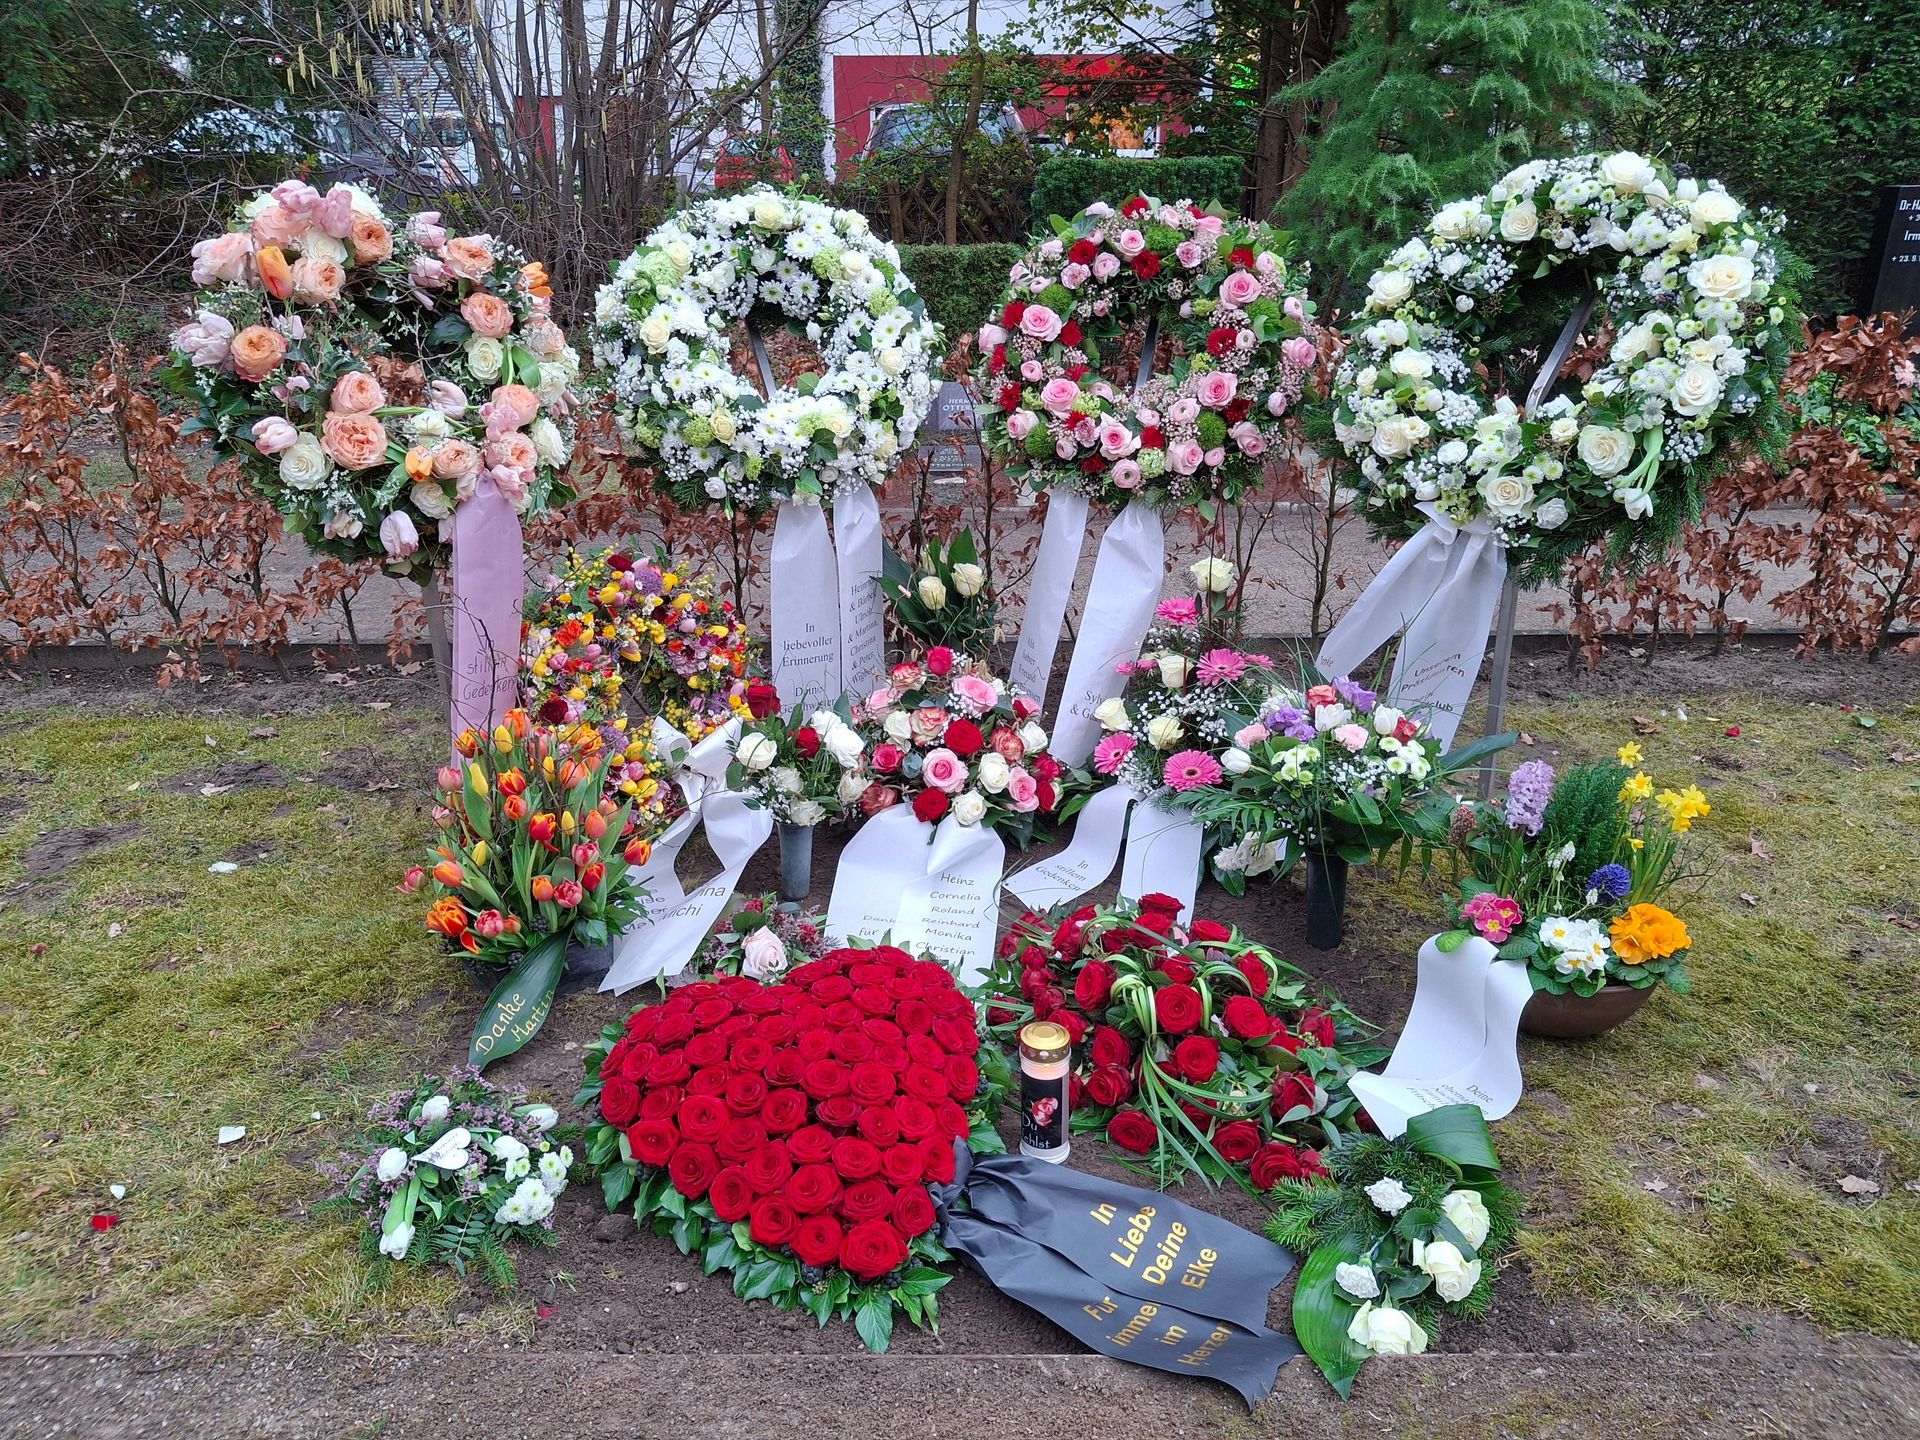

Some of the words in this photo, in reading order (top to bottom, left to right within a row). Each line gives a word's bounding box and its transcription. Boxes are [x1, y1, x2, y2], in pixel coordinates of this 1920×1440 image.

[805, 622, 815, 633] In
[783, 635, 833, 651] liebevoller
[782, 652, 834, 668] Erinnerung
[1414, 653, 1461, 678] Unserem
[795, 685, 823, 698] Dine
[1070, 703, 1079, 716] &
[1077, 860, 1089, 869] In
[940, 872, 976, 886] Heinz
[1035, 866, 1082, 892] Gedenken
[1055, 864, 1087, 882] stillem
[930, 891, 982, 901] Cornelia
[931, 906, 976, 915] Roland
[921, 917, 981, 929] Reinhard
[859, 927, 879, 936] für
[925, 927, 973, 941] Monika
[915, 941, 976, 955] Christian
[510, 988, 555, 1042] Martin
[475, 993, 526, 1056] Danke
[1466, 1084, 1494, 1103] Deine
[1022, 1110, 1038, 1131] Du
[1090, 1202, 1118, 1226] In
[1109, 1205, 1158, 1269] Liebe
[1141, 1221, 1188, 1287] Deine
[1180, 1247, 1218, 1290] Elke
